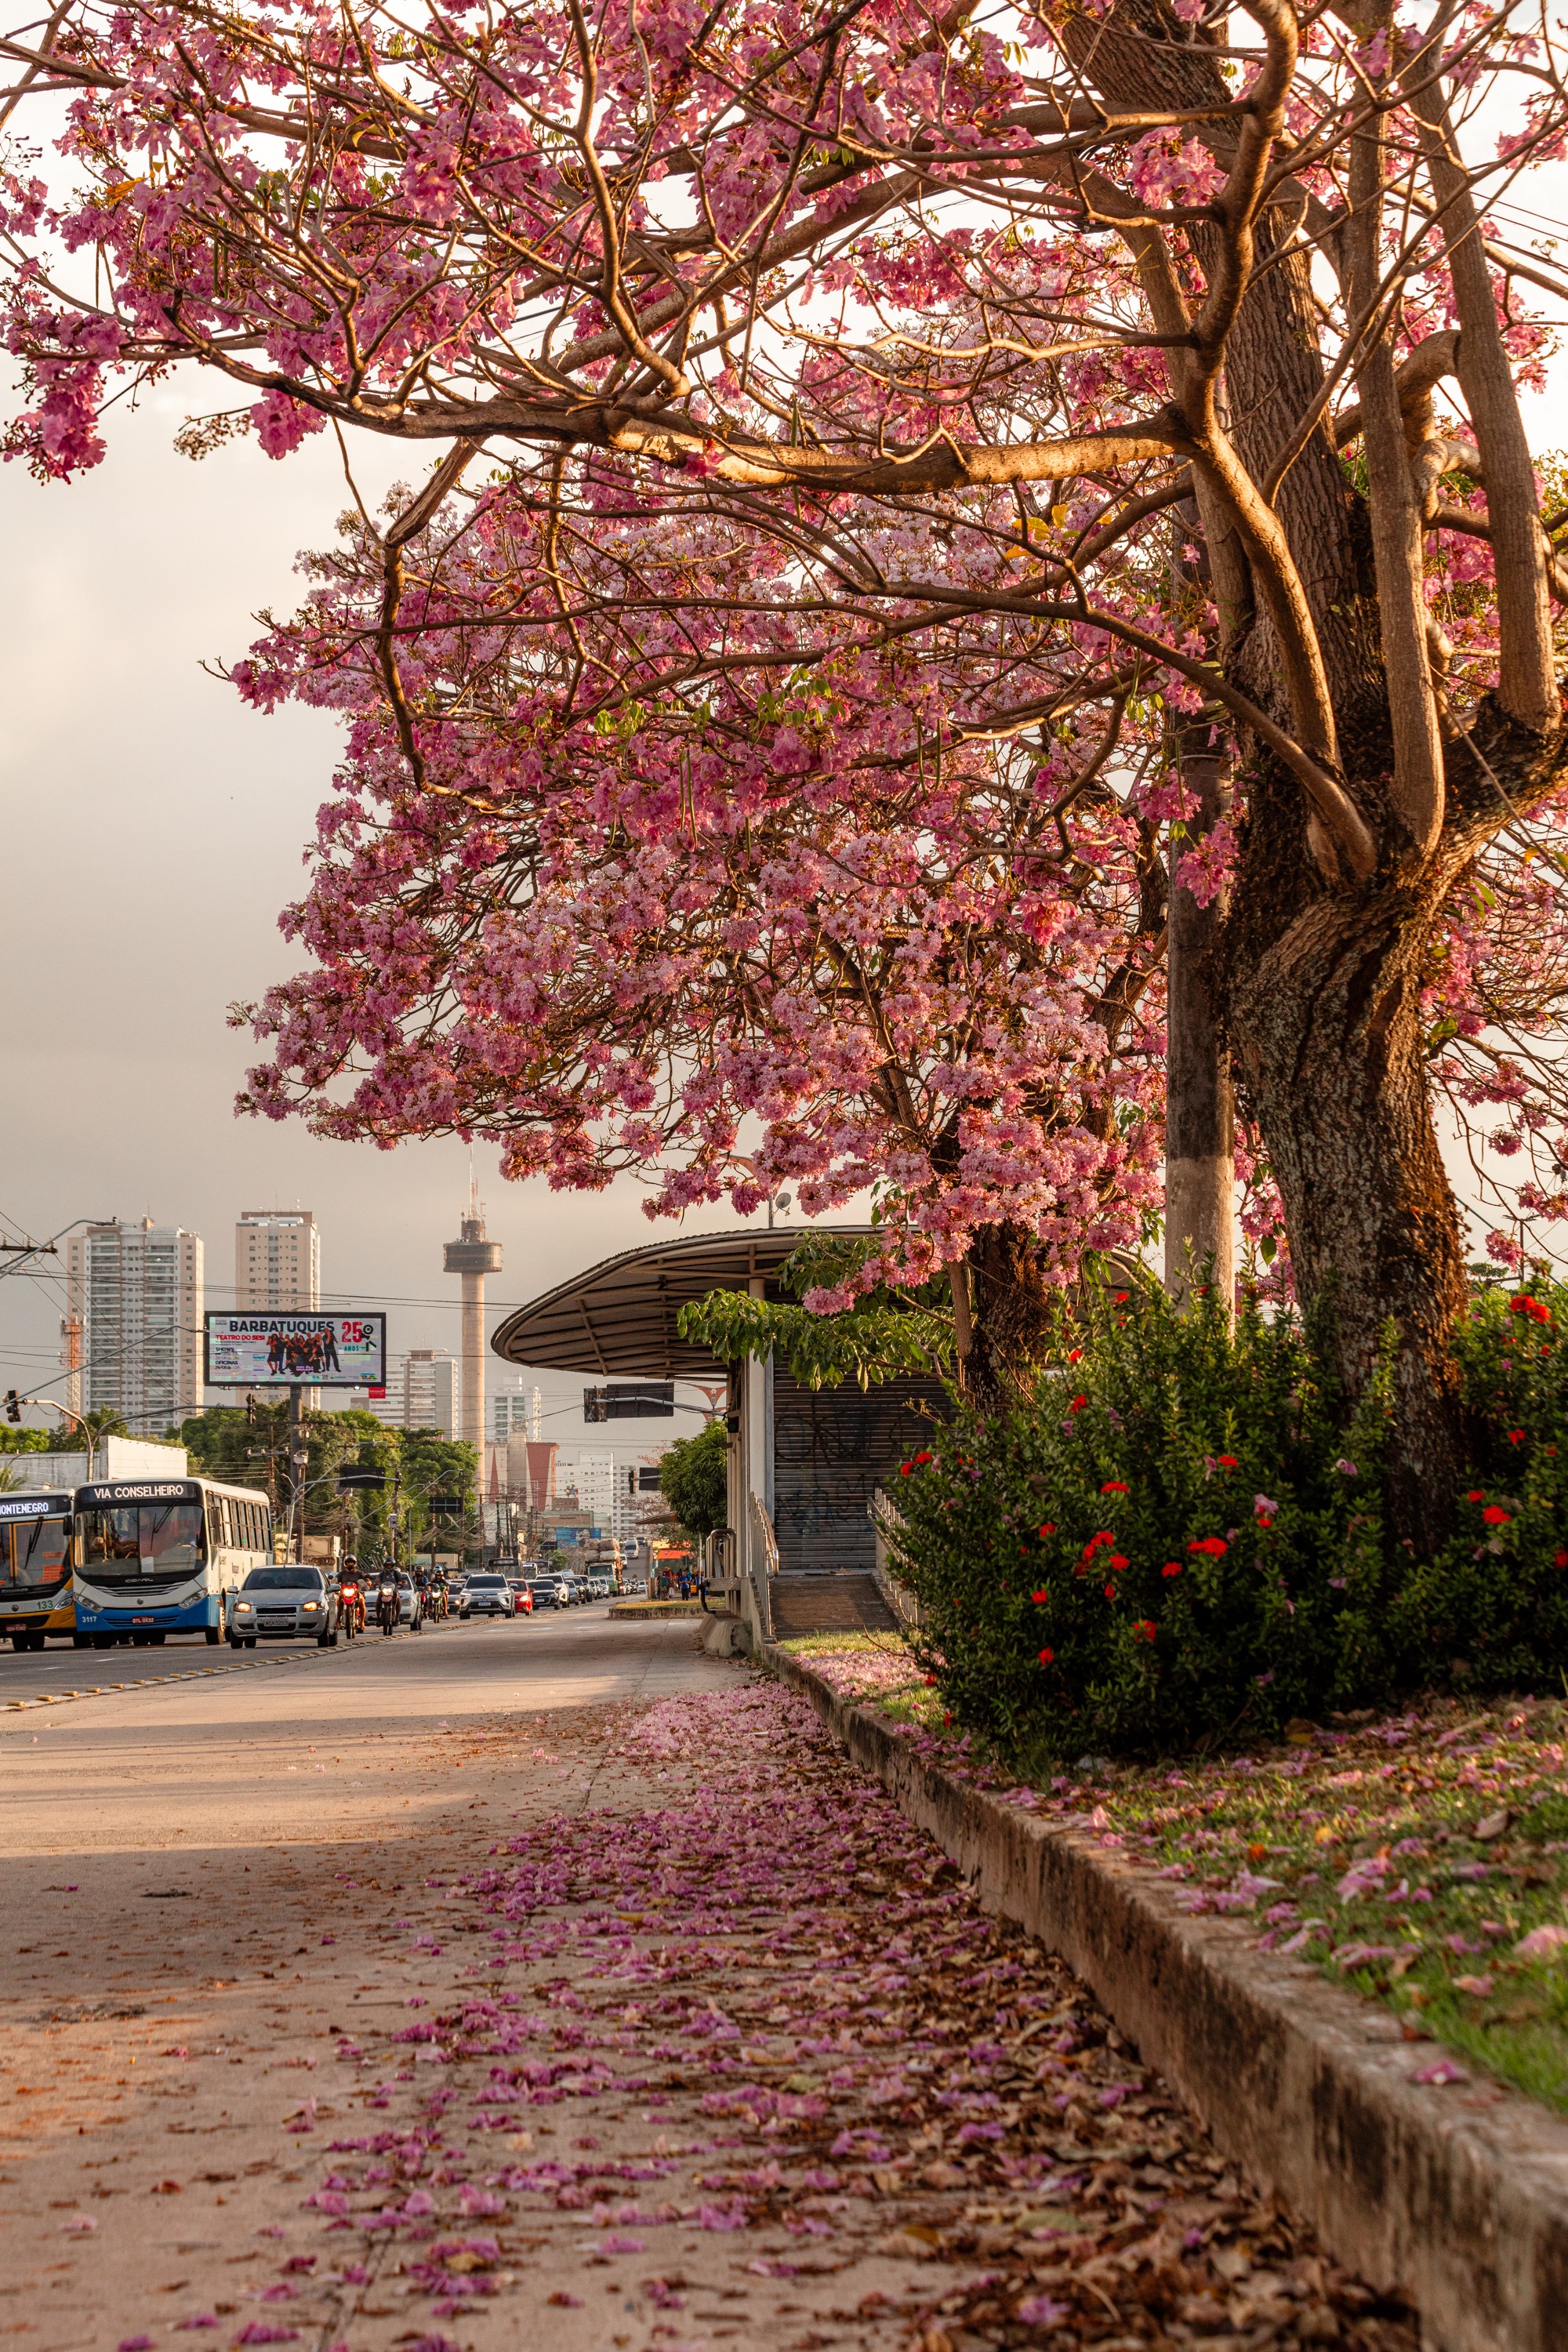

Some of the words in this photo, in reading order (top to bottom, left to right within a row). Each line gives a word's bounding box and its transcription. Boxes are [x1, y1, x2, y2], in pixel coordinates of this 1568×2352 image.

[230, 1320, 335, 1334] BARBATUQUES
[341, 1321, 363, 1343] 25
[94, 1487, 111, 1498] VIA
[114, 1484, 183, 1498] CONSELHEIRO
[37, 1600, 54, 1610] 133
